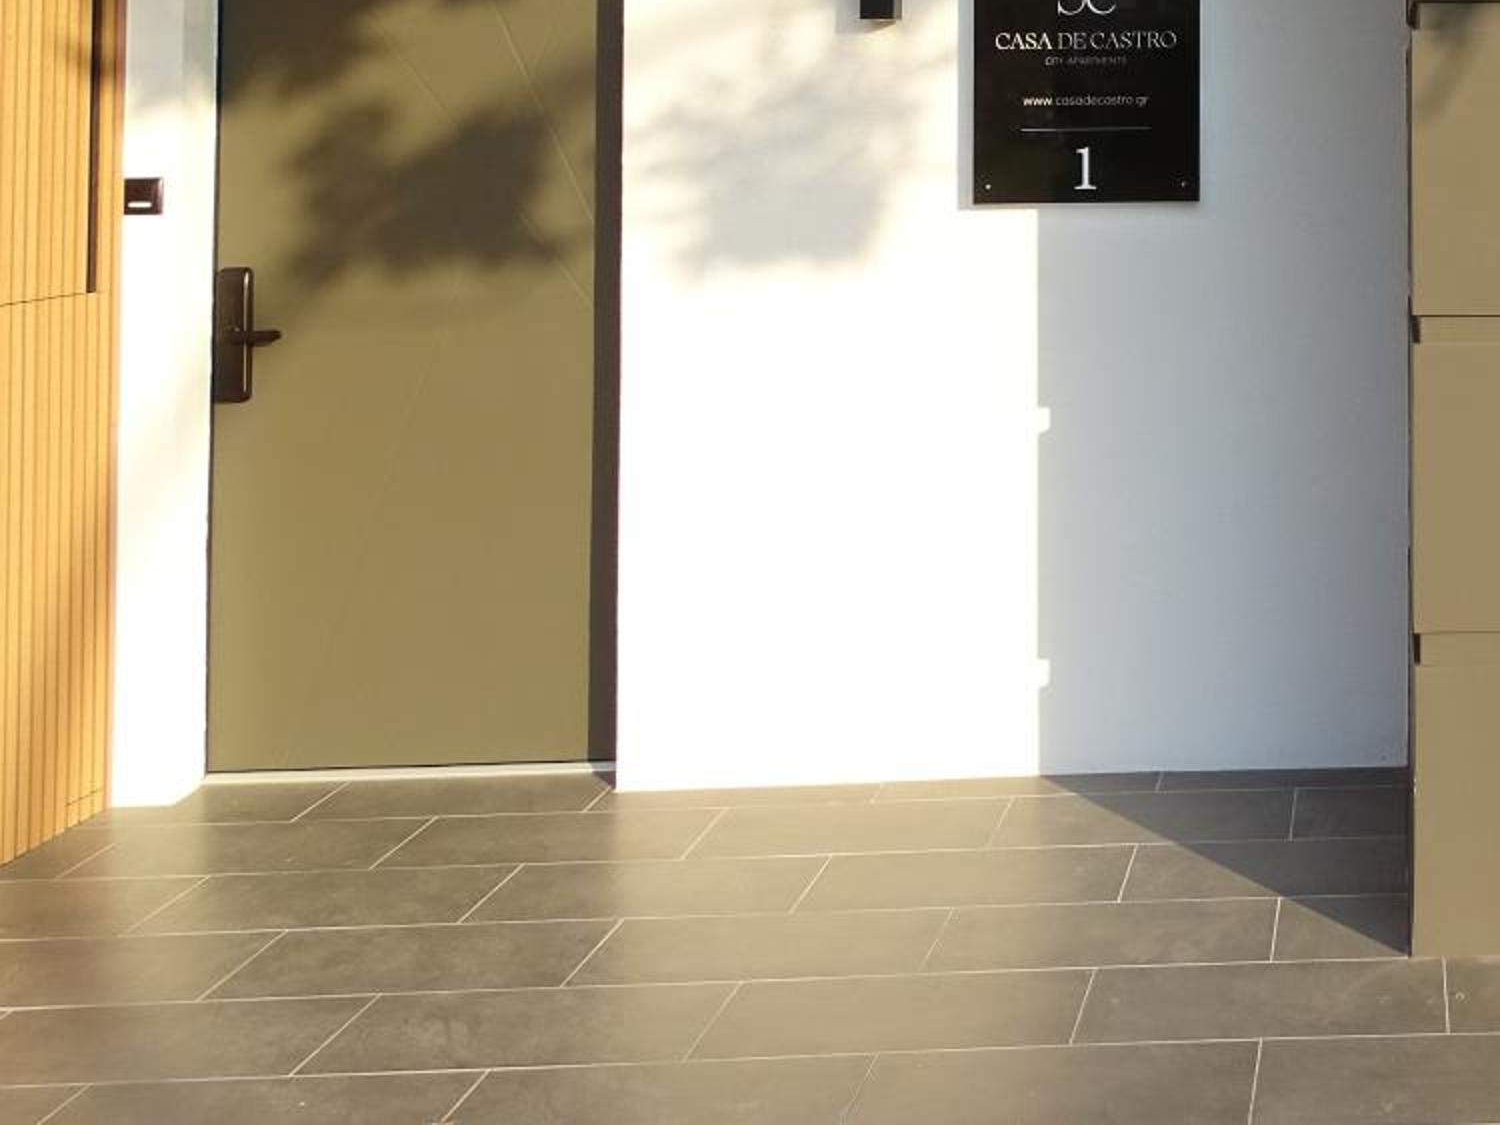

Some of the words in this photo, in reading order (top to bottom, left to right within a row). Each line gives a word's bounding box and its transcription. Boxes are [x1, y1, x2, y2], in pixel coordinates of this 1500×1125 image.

[995, 32, 1053, 50] CASA
[1057, 32, 1087, 50] DE
[1089, 30, 1178, 50] CASTRO
[1073, 146, 1098, 191] 1
